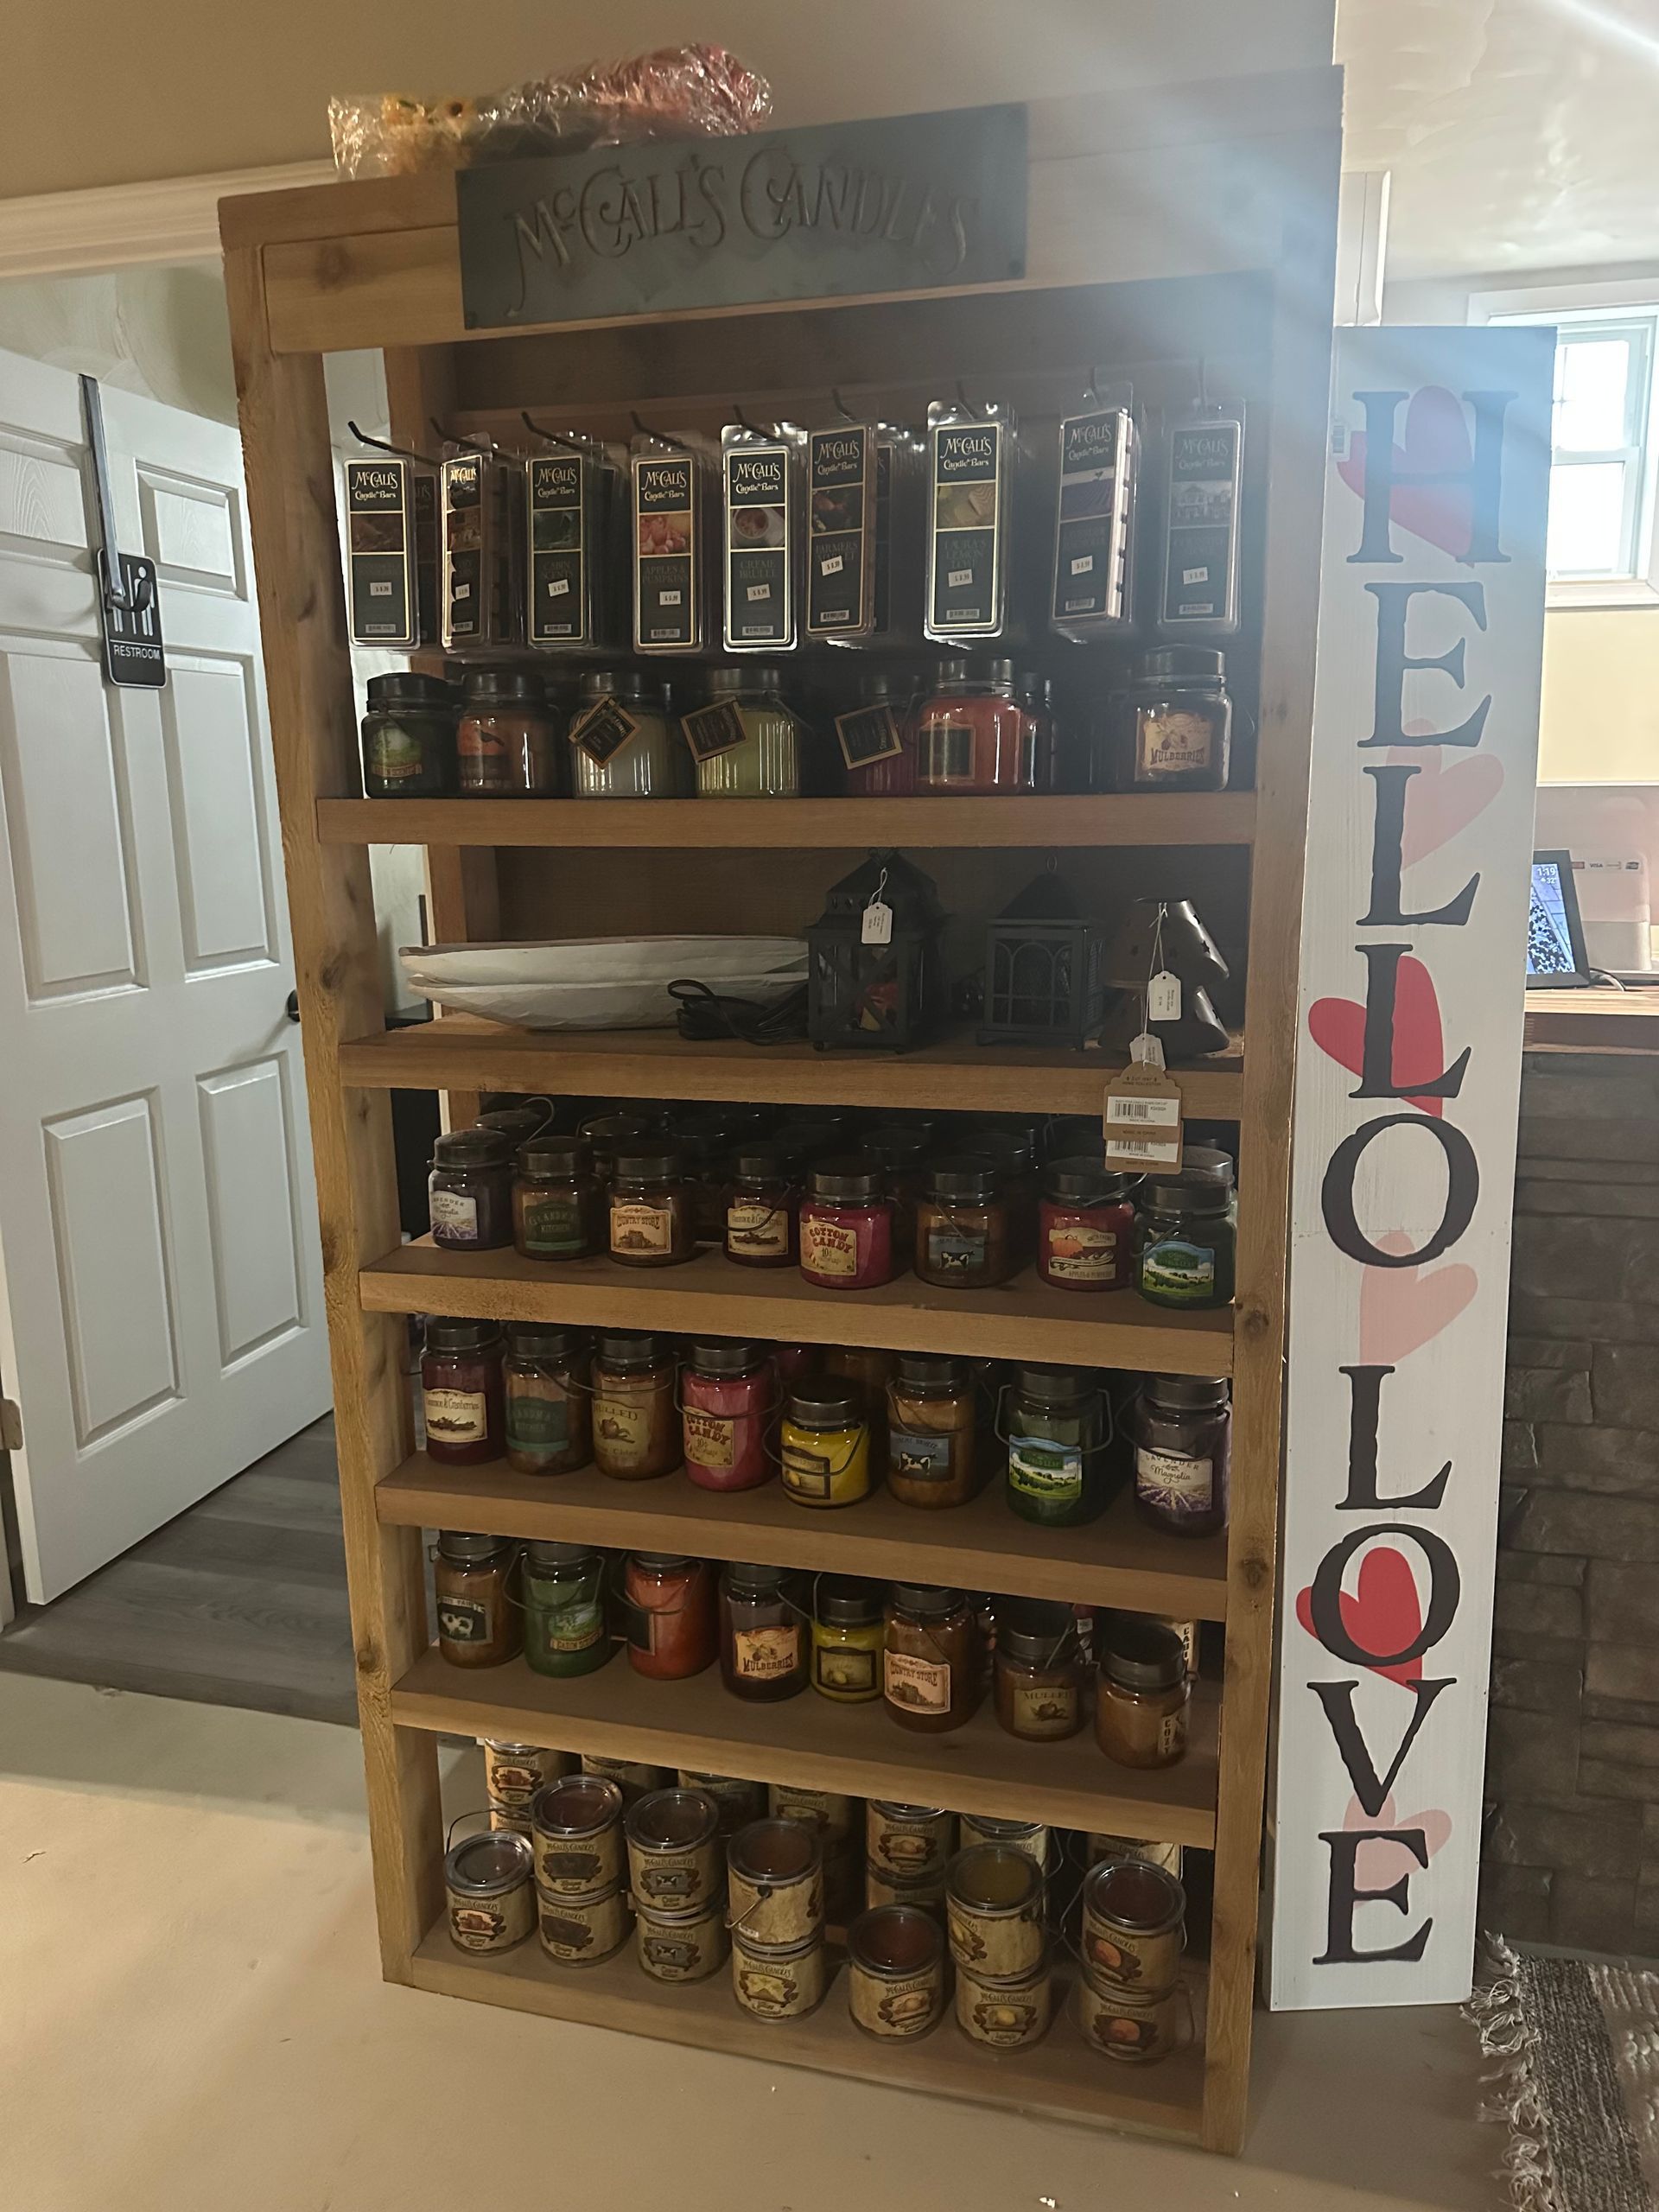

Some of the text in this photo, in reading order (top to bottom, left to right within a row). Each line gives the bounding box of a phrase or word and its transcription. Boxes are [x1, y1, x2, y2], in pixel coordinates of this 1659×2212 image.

[741, 145, 982, 276] CANDLES
[113, 645, 161, 660] RESTROOM
[1149, 747, 1205, 765] MULBERRIES
[1537, 867, 1556, 876] 1:19
[1306, 391, 1519, 1965] HELLO LOVE
[810, 1227, 849, 1242] COTTON
[813, 1237, 854, 1254] CANDY
[690, 1425, 731, 1445] CANDY
[743, 1652, 793, 1672] MULBERRIES
[917, 1671, 938, 1687] STORE
